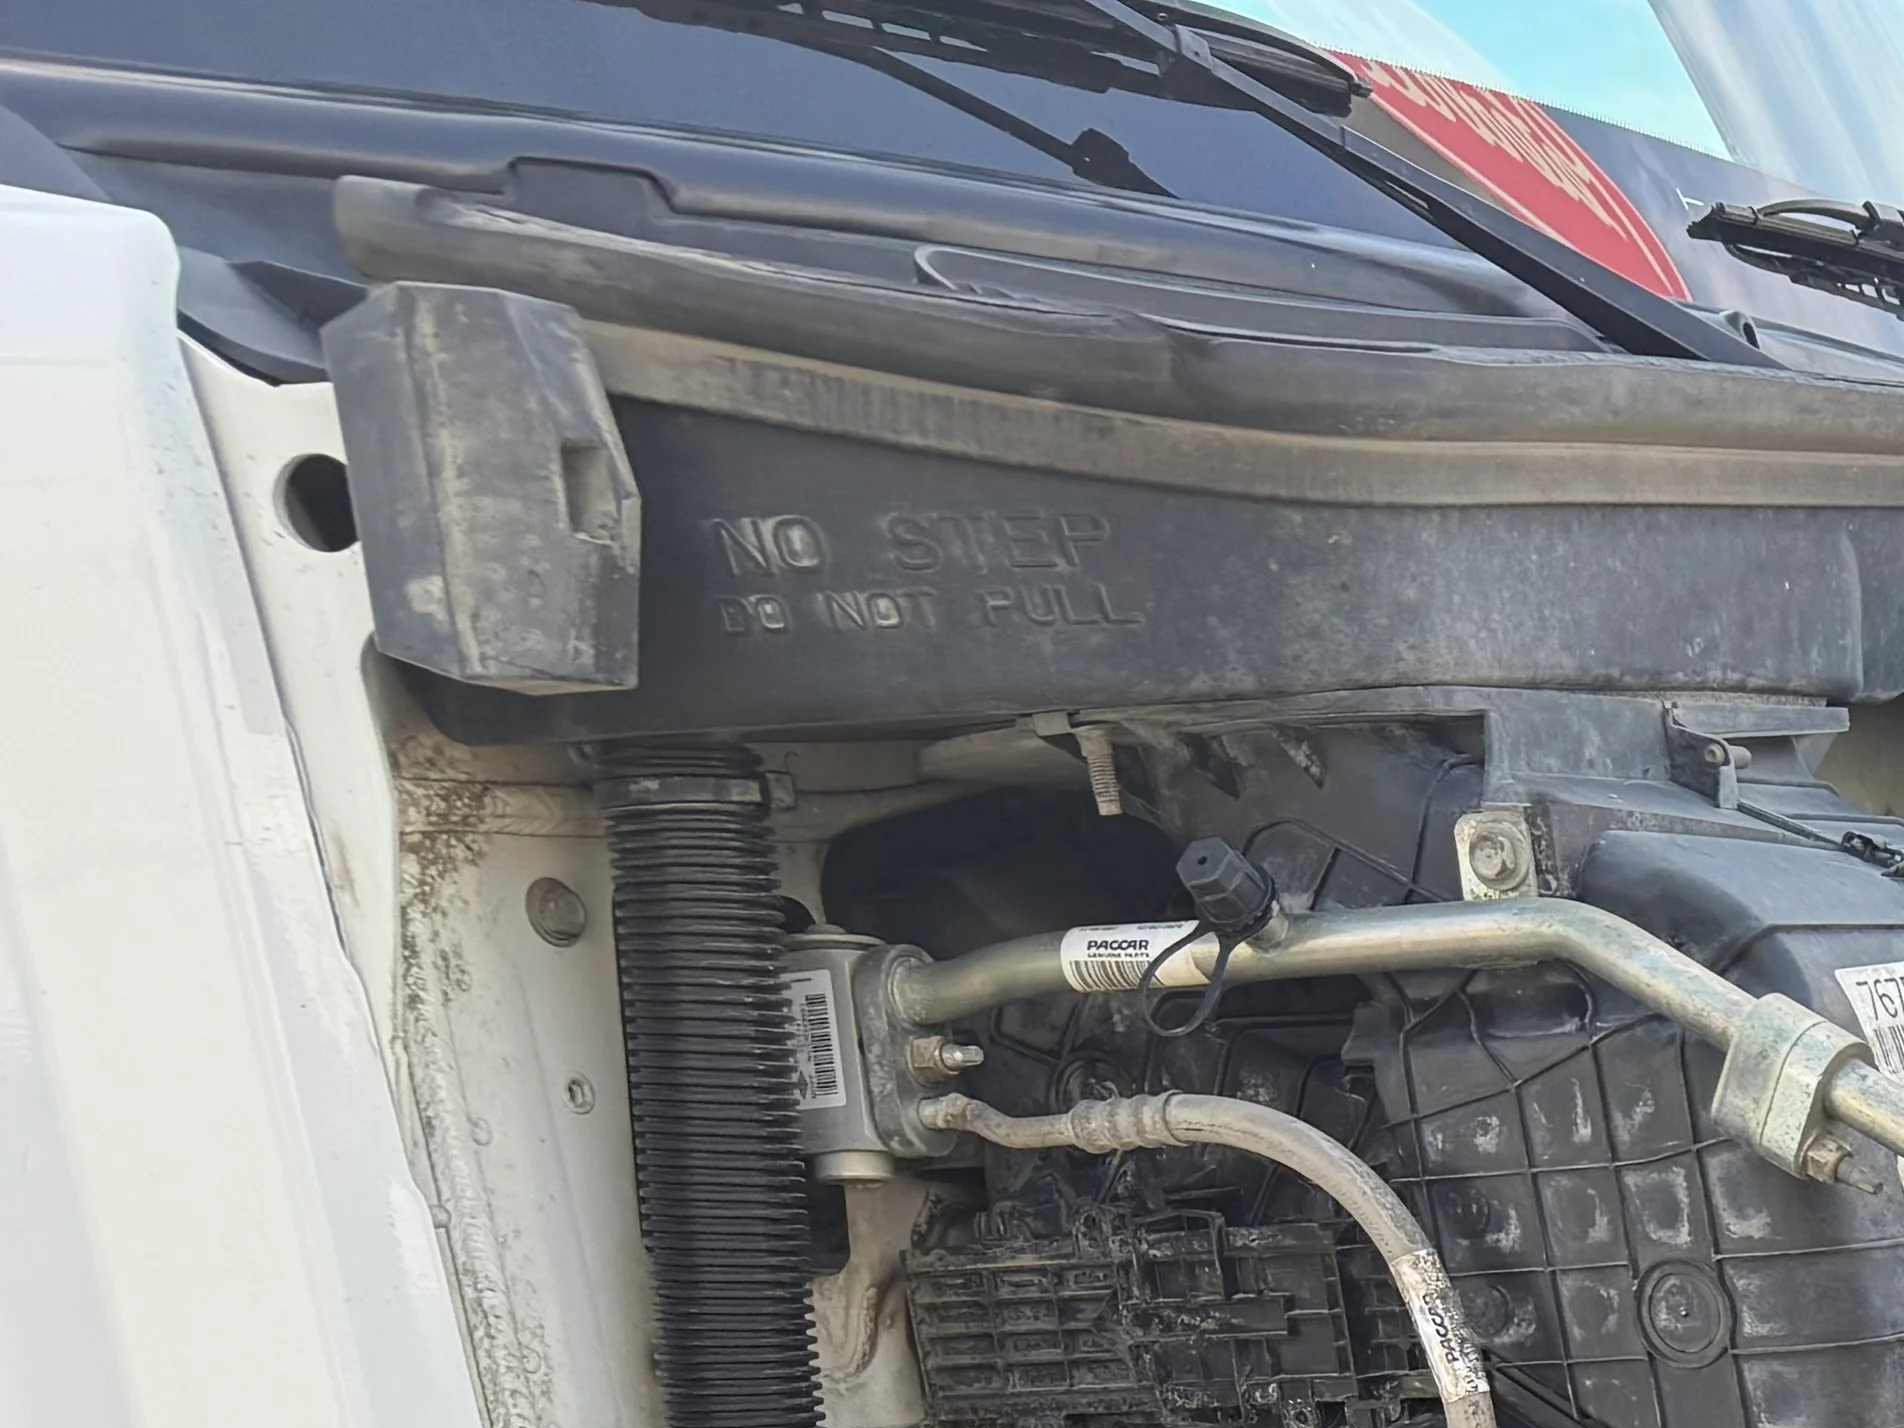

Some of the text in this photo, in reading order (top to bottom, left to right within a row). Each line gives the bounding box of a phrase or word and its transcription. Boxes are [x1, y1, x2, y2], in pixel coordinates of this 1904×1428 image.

[712, 508, 1110, 577] NO STEP
[719, 584, 1147, 634] DO NOT PULL
[1087, 939, 1149, 951] PACCAR
